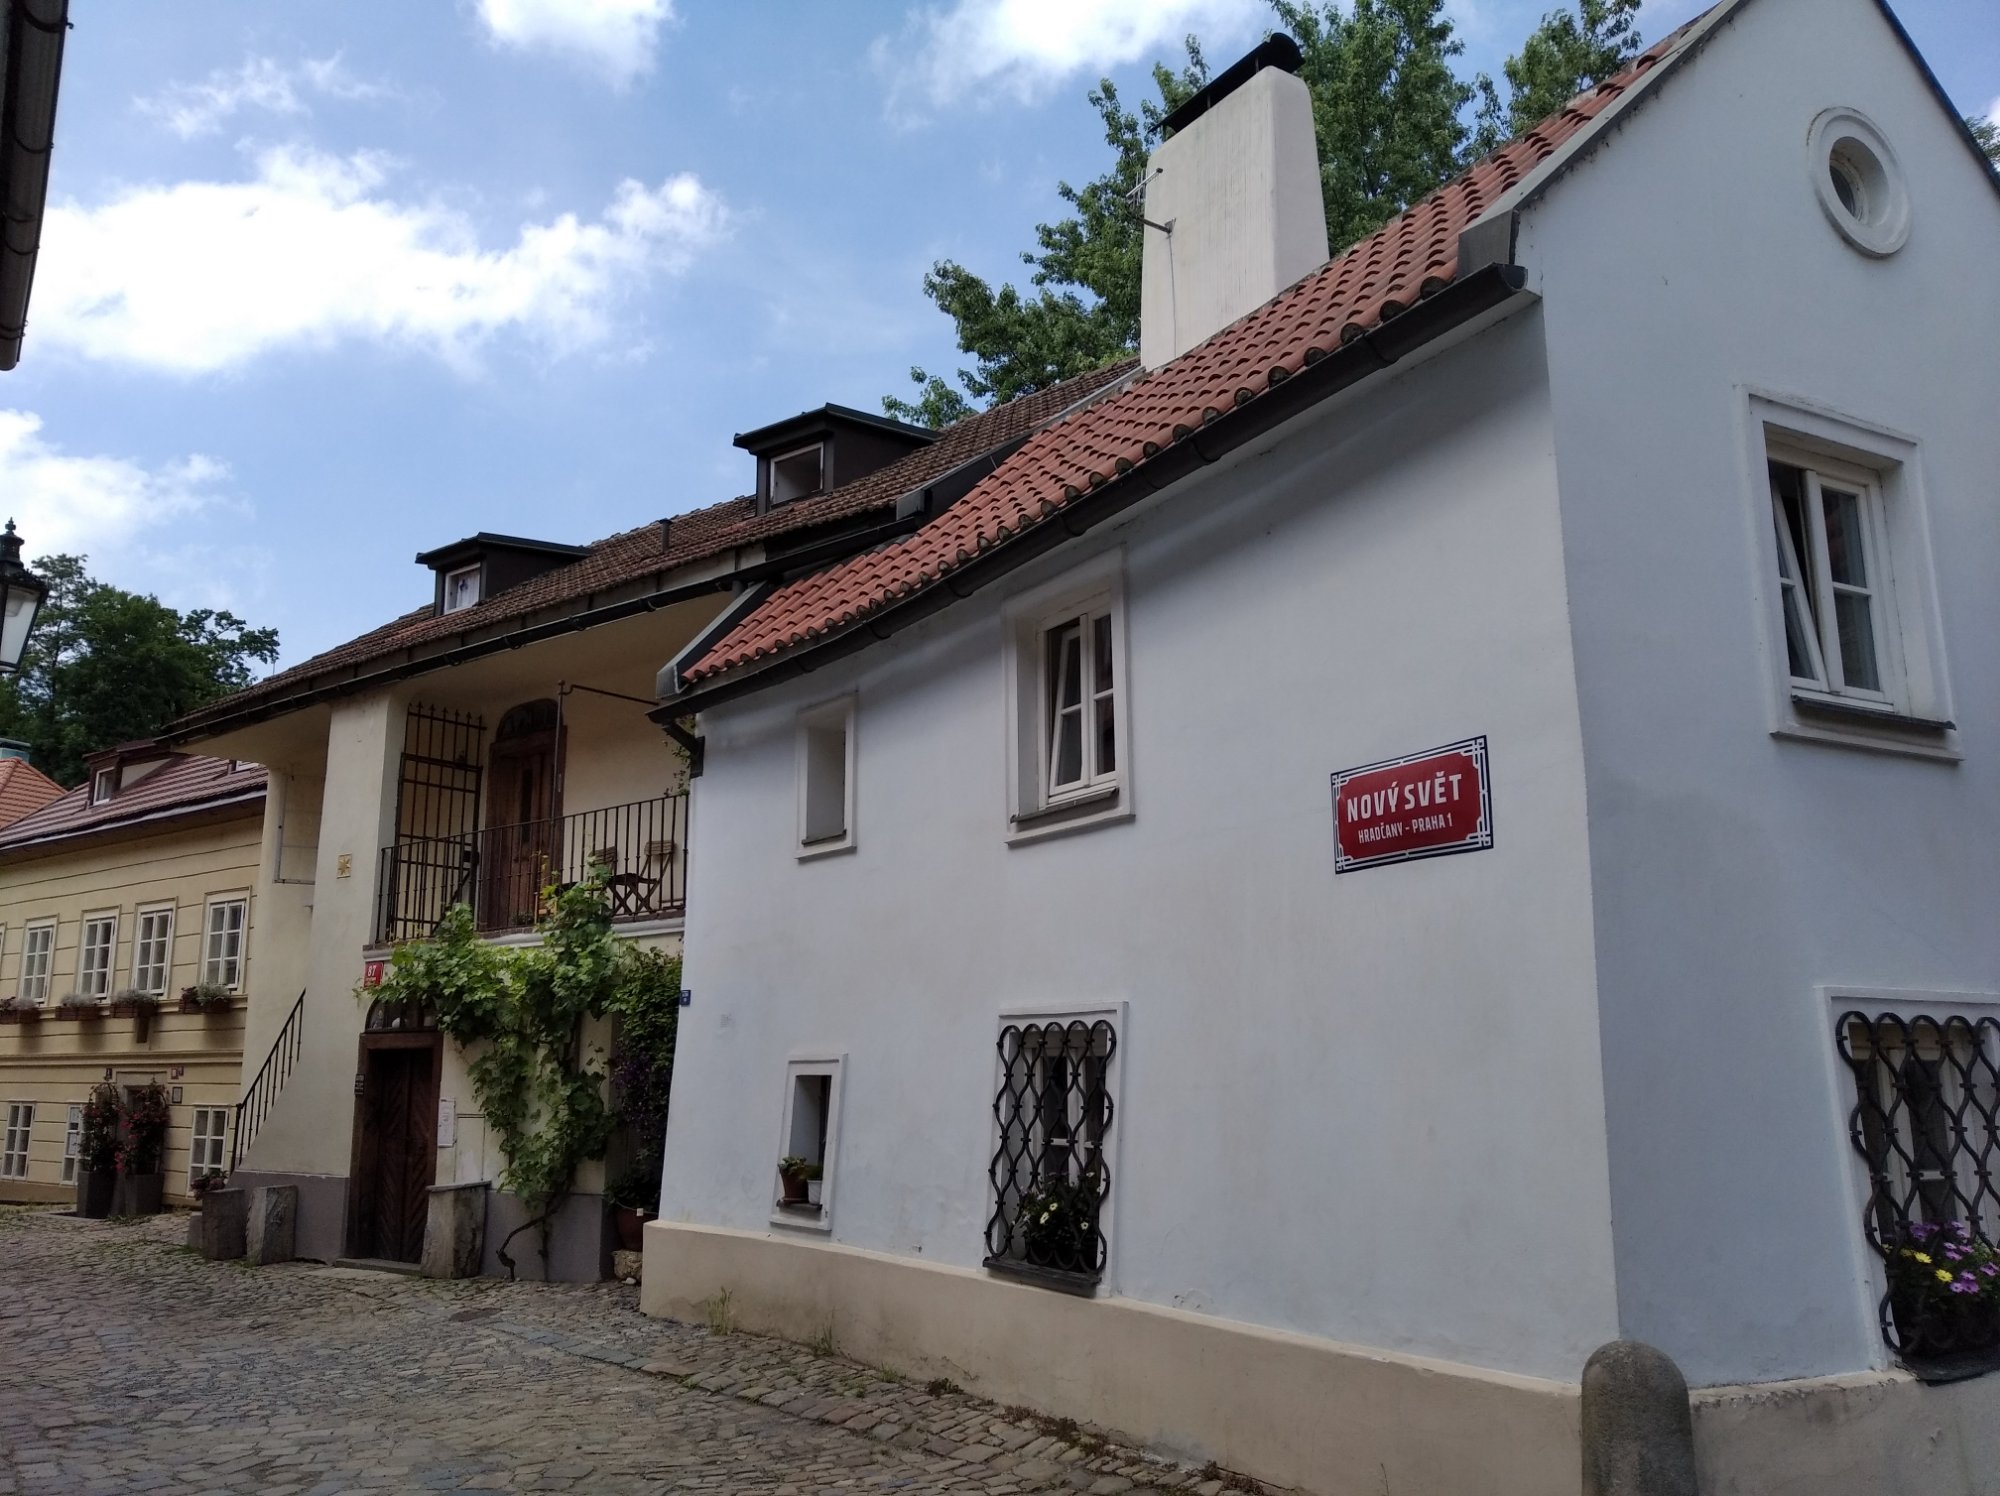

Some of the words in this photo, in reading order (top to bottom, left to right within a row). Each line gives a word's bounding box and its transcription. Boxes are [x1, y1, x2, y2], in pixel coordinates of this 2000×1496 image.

[1347, 781, 1399, 823] NOVÝ
[1404, 771, 1462, 810] SVĚT
[1358, 822, 1403, 844] HRADČANY
[1412, 814, 1445, 833] PRAHA
[1447, 813, 1453, 827] 1
[367, 965, 377, 977] 87
